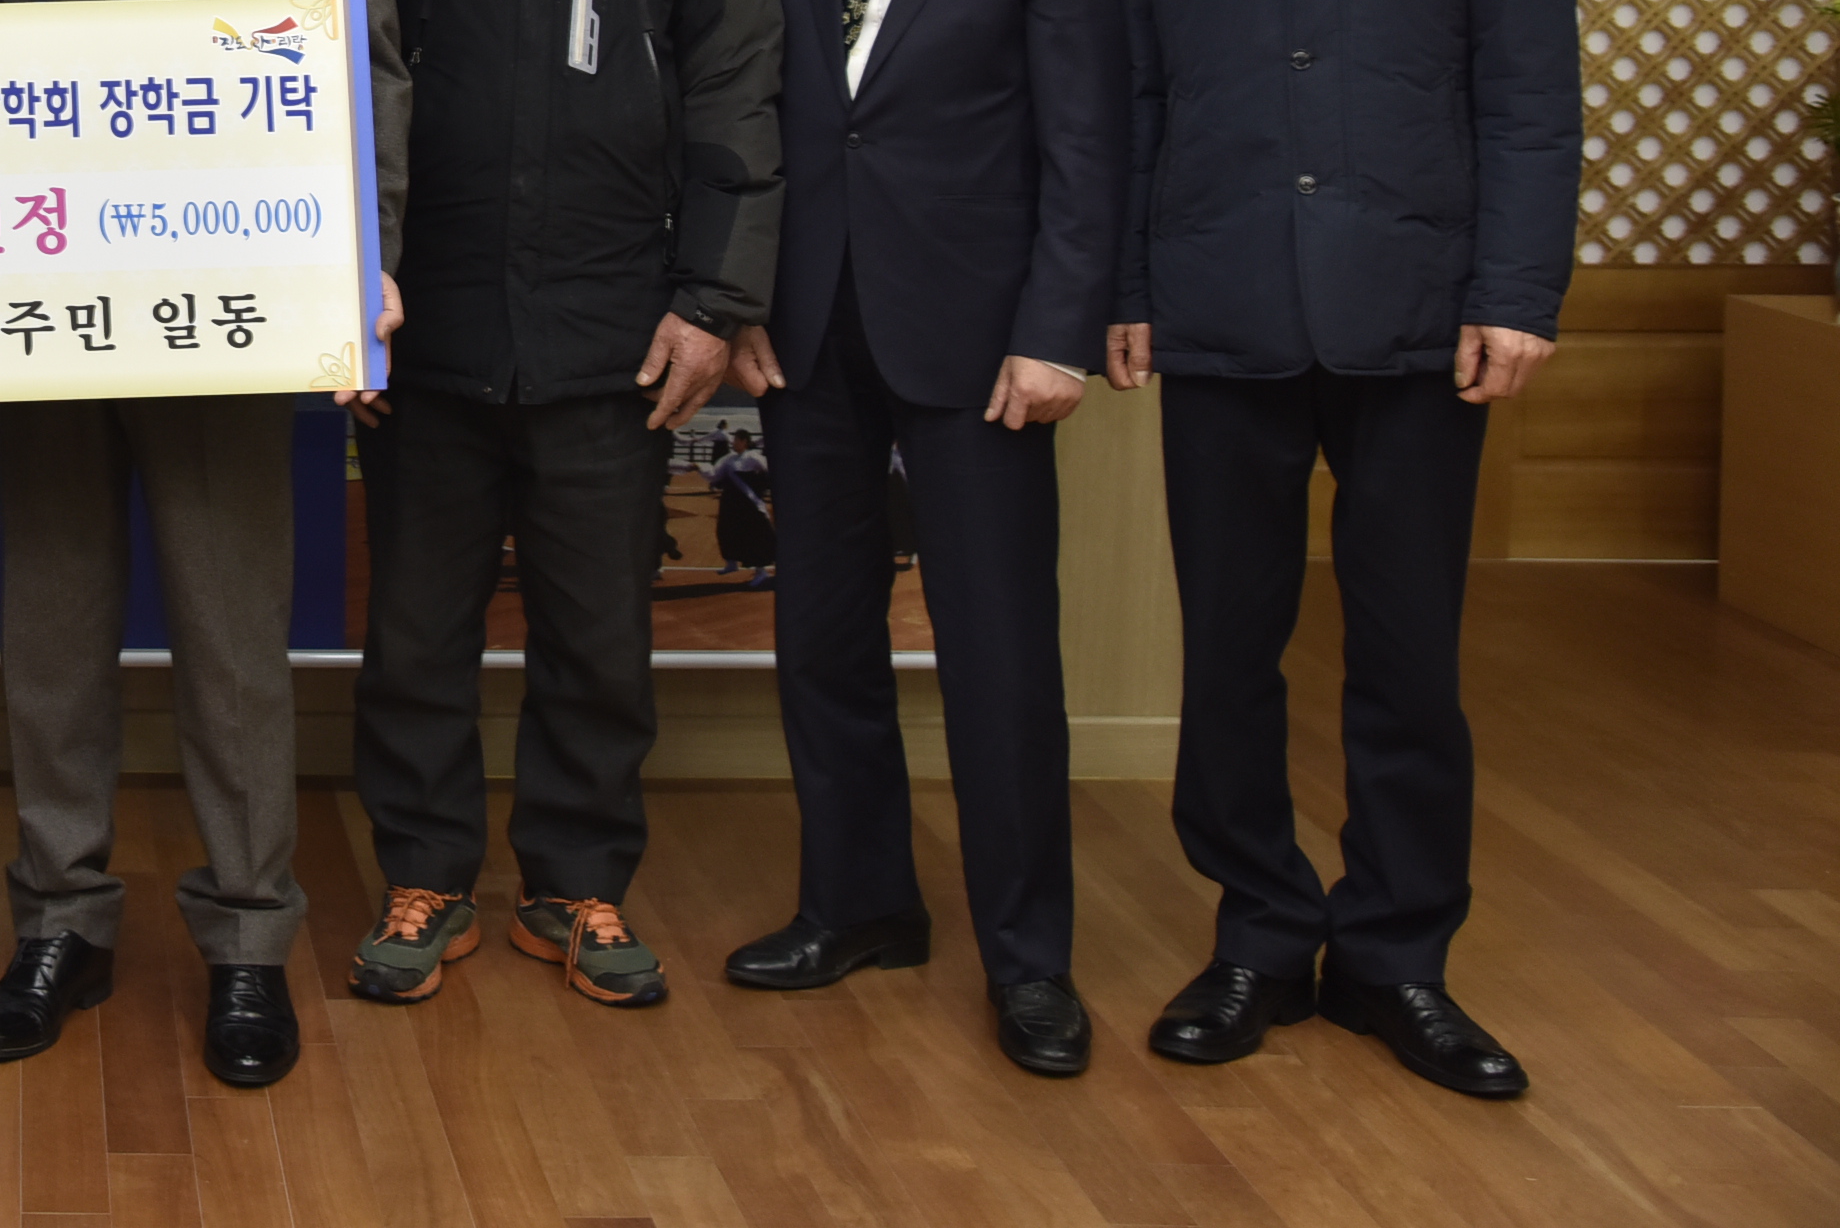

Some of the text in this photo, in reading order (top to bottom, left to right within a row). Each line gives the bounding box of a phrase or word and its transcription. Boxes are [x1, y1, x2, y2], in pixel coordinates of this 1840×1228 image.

[100, 77, 221, 139] 장학금
[239, 75, 318, 133] 기탁
[0, 295, 117, 356] 주민
[150, 292, 268, 350] 일동
